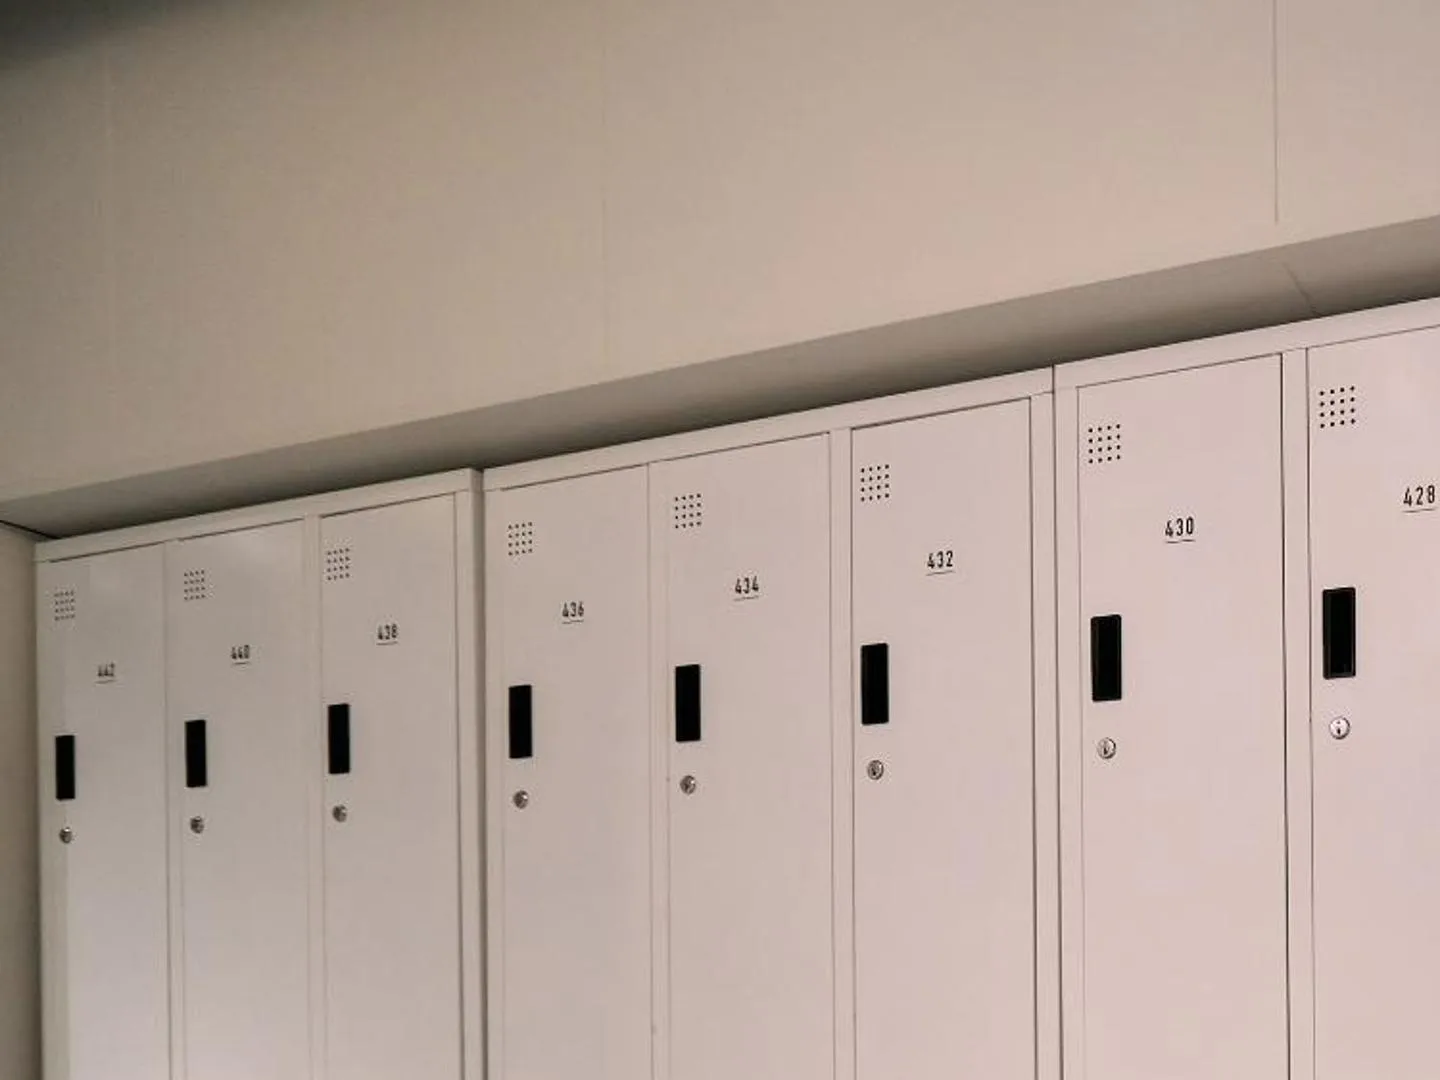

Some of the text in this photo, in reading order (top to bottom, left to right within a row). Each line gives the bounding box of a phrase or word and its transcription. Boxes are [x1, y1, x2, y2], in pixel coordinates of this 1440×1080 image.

[1403, 484, 1436, 506] 428
[1165, 516, 1195, 538] 430
[927, 550, 954, 570] 432
[735, 577, 759, 596] 434
[562, 601, 584, 619] 436
[377, 622, 398, 641] 438
